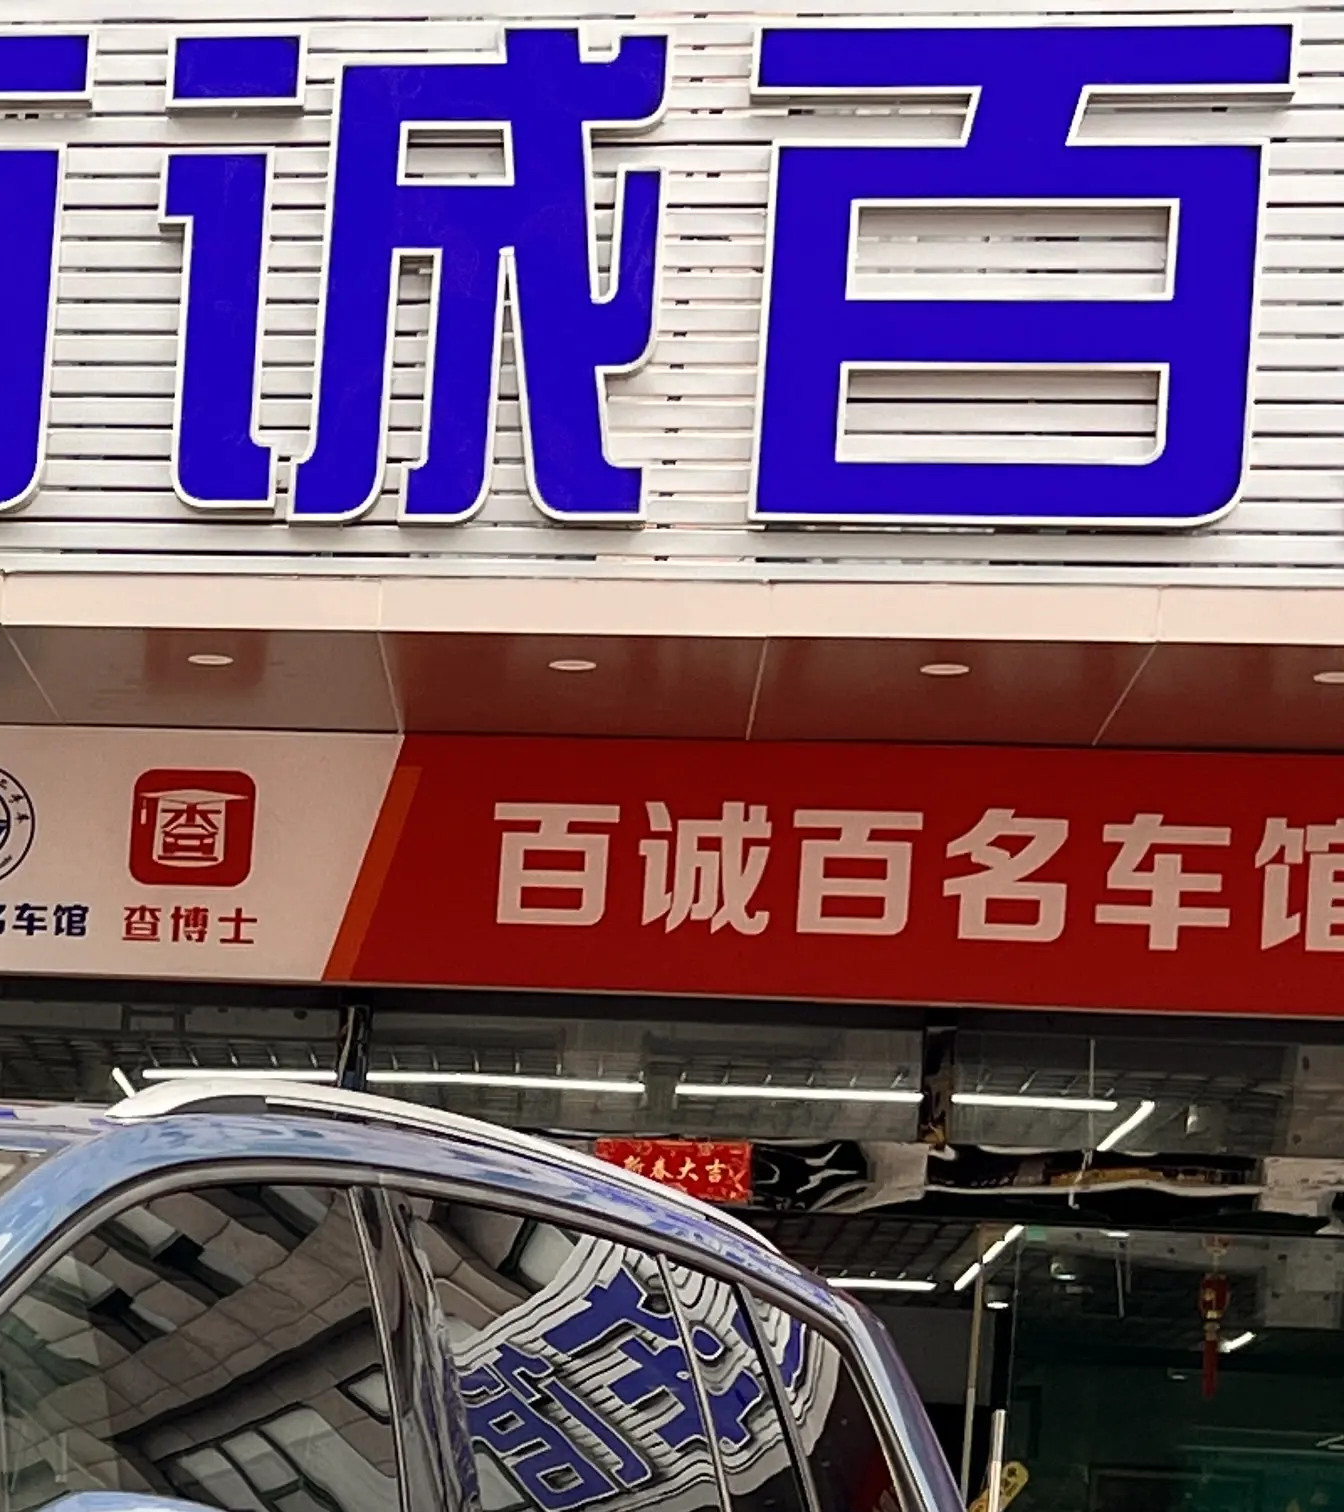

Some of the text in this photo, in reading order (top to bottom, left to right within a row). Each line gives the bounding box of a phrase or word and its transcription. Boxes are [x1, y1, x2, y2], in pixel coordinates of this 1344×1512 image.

[493, 800, 1344, 952] 百诚百名车馆
[121, 904, 258, 945] 查博士
